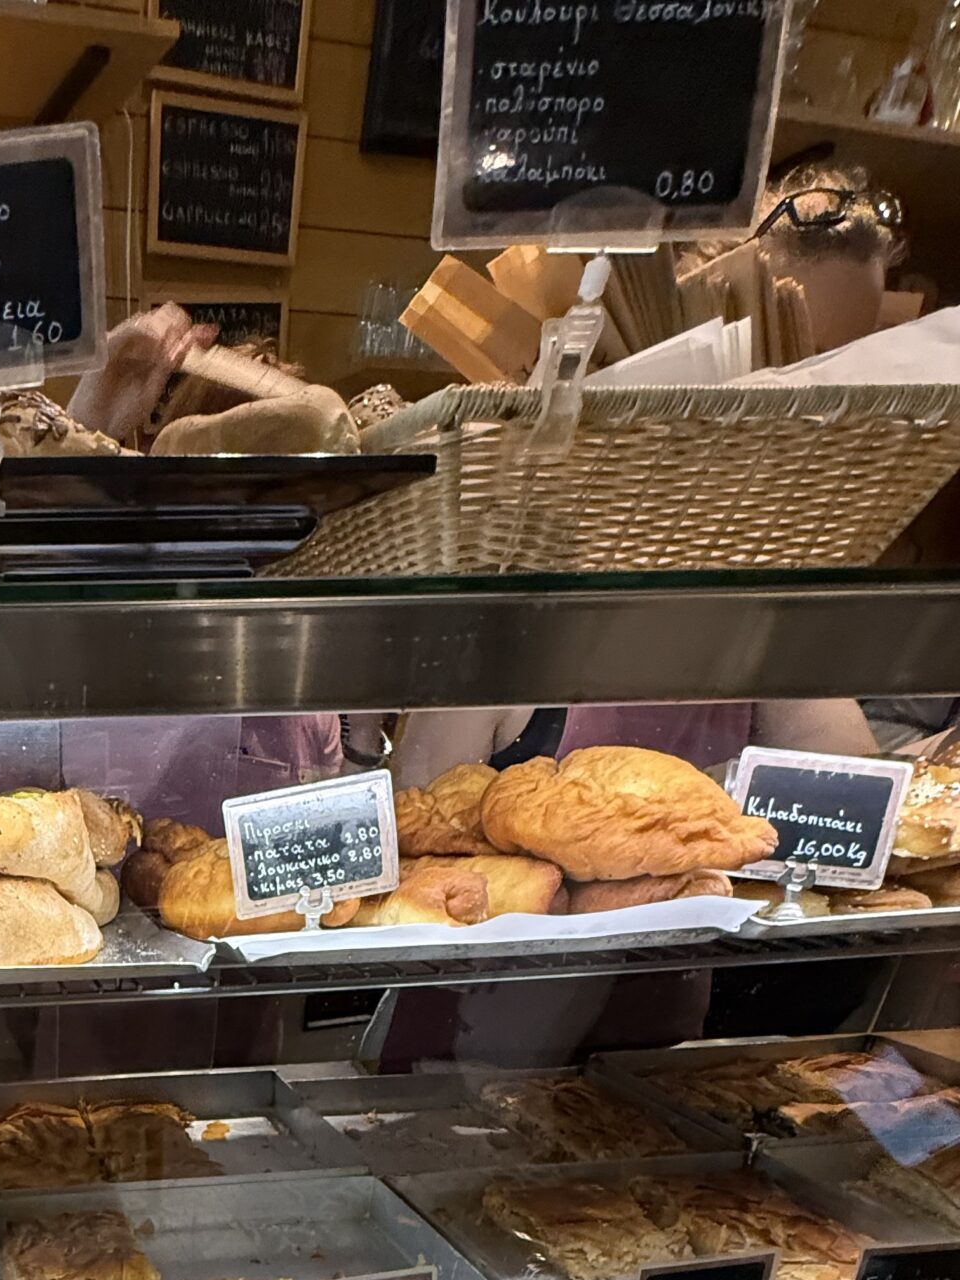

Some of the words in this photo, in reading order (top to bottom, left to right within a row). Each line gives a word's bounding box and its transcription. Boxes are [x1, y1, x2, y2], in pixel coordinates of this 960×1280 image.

[490, 46, 600, 92] σταρένιο
[654, 169, 715, 200] 0,80
[746, 795, 863, 834] Κιμαδοπιτάκι
[792, 838, 845, 859] 16,00
[846, 842, 868, 868] Kg
[312, 868, 346, 887] 3,50
